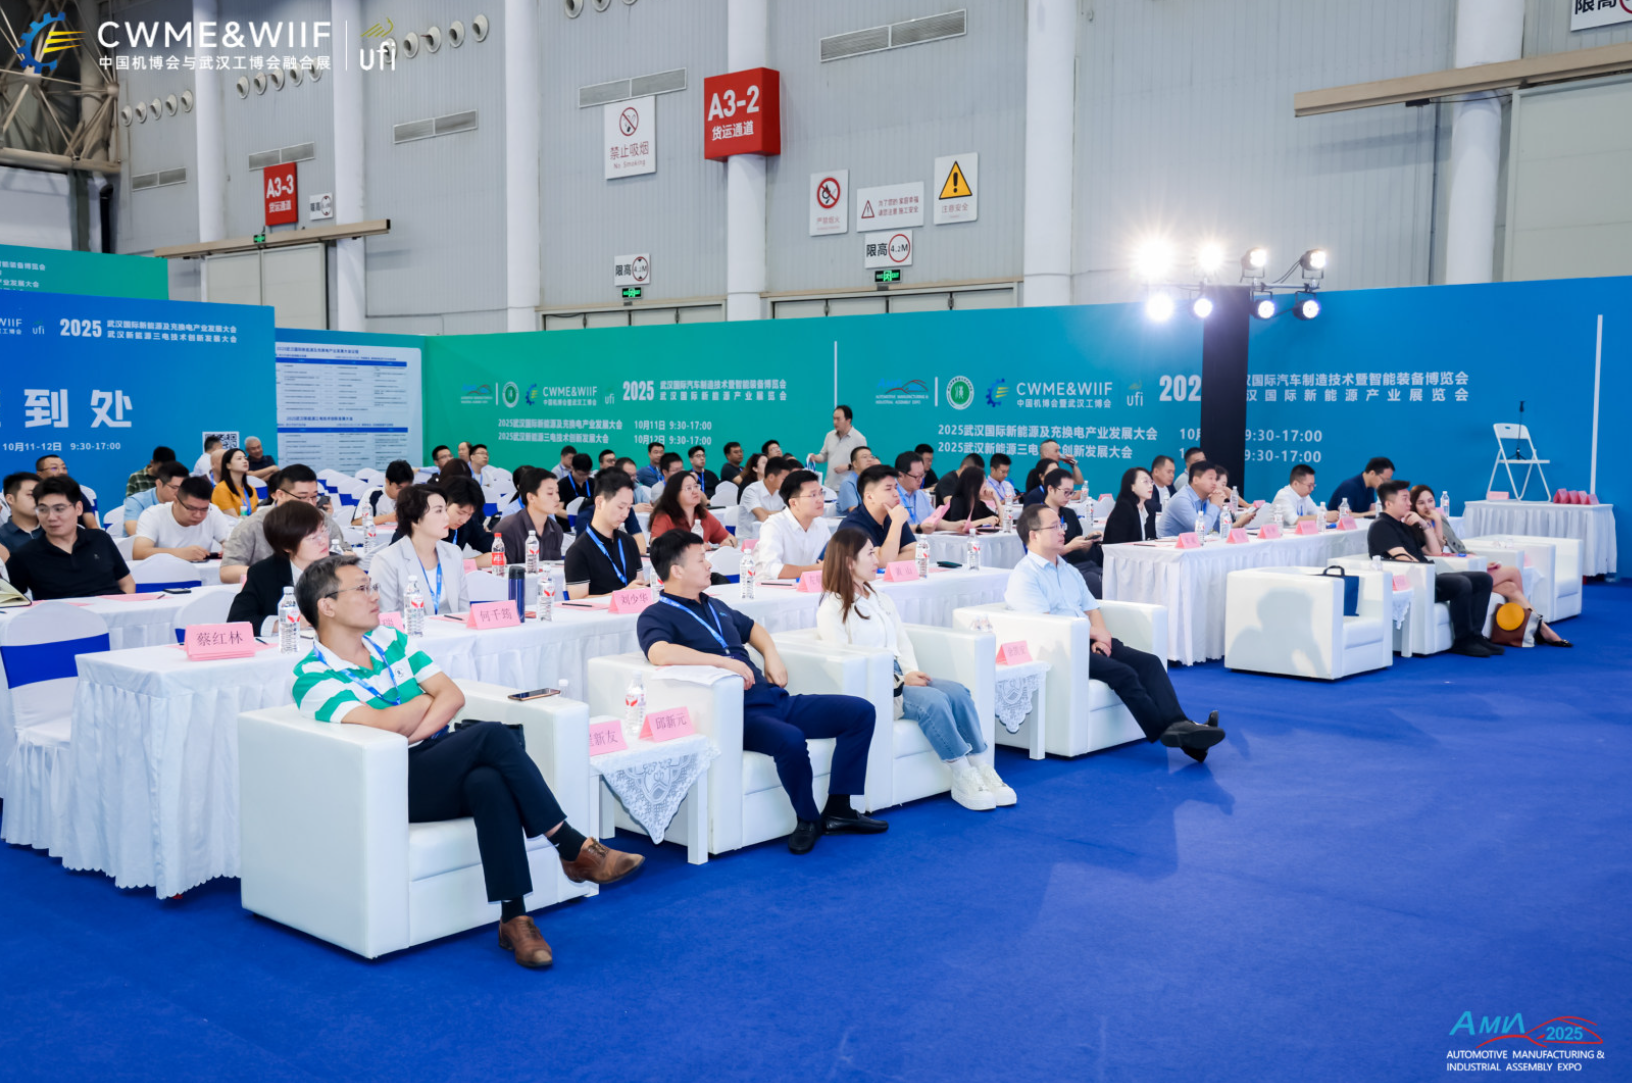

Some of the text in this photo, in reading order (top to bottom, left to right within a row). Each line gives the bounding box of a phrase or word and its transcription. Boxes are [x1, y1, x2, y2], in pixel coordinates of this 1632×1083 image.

[707, 85, 760, 121] A3-2
[711, 120, 755, 141] 货运通道
[609, 141, 650, 160] 禁止吸烟
[266, 174, 294, 199] A3-3
[942, 202, 969, 214] 注意安全
[866, 243, 888, 257] 限高
[615, 263, 632, 277] 限高
[0, 279, 39, 288] 业发展大会
[59, 318, 102, 338] 2025
[1246, 371, 1469, 387] 国际汽车制造技术暨智能装备博览会
[542, 386, 598, 397] CWME&WIIF
[622, 380, 654, 401] 2025
[1016, 382, 1113, 397] CWME&WIIF
[1159, 375, 1201, 402] 202
[1246, 388, 1469, 402] 汉国际新能源产业展览会
[1016, 399, 1112, 409] 中国机博会暨武汉工博会
[1126, 393, 1144, 407] ufi
[0, 389, 133, 429] 到处
[634, 420, 712, 431] 10月11日 9:30-17:00
[938, 424, 1158, 441] 2025武汉国际新能源及充换电产业发展大会
[669, 435, 712, 445] 9:30-17:00
[1244, 430, 1322, 443] 9:30-17:00
[2, 442, 121, 452] 10月11-12日 9:30-17:00
[938, 442, 1133, 459] 2025武汉新能源三电创新发展大会
[1244, 450, 1322, 463] 9:30-17:00
[196, 631, 243, 647] 蔡红林
[655, 711, 688, 730] 邱新元
